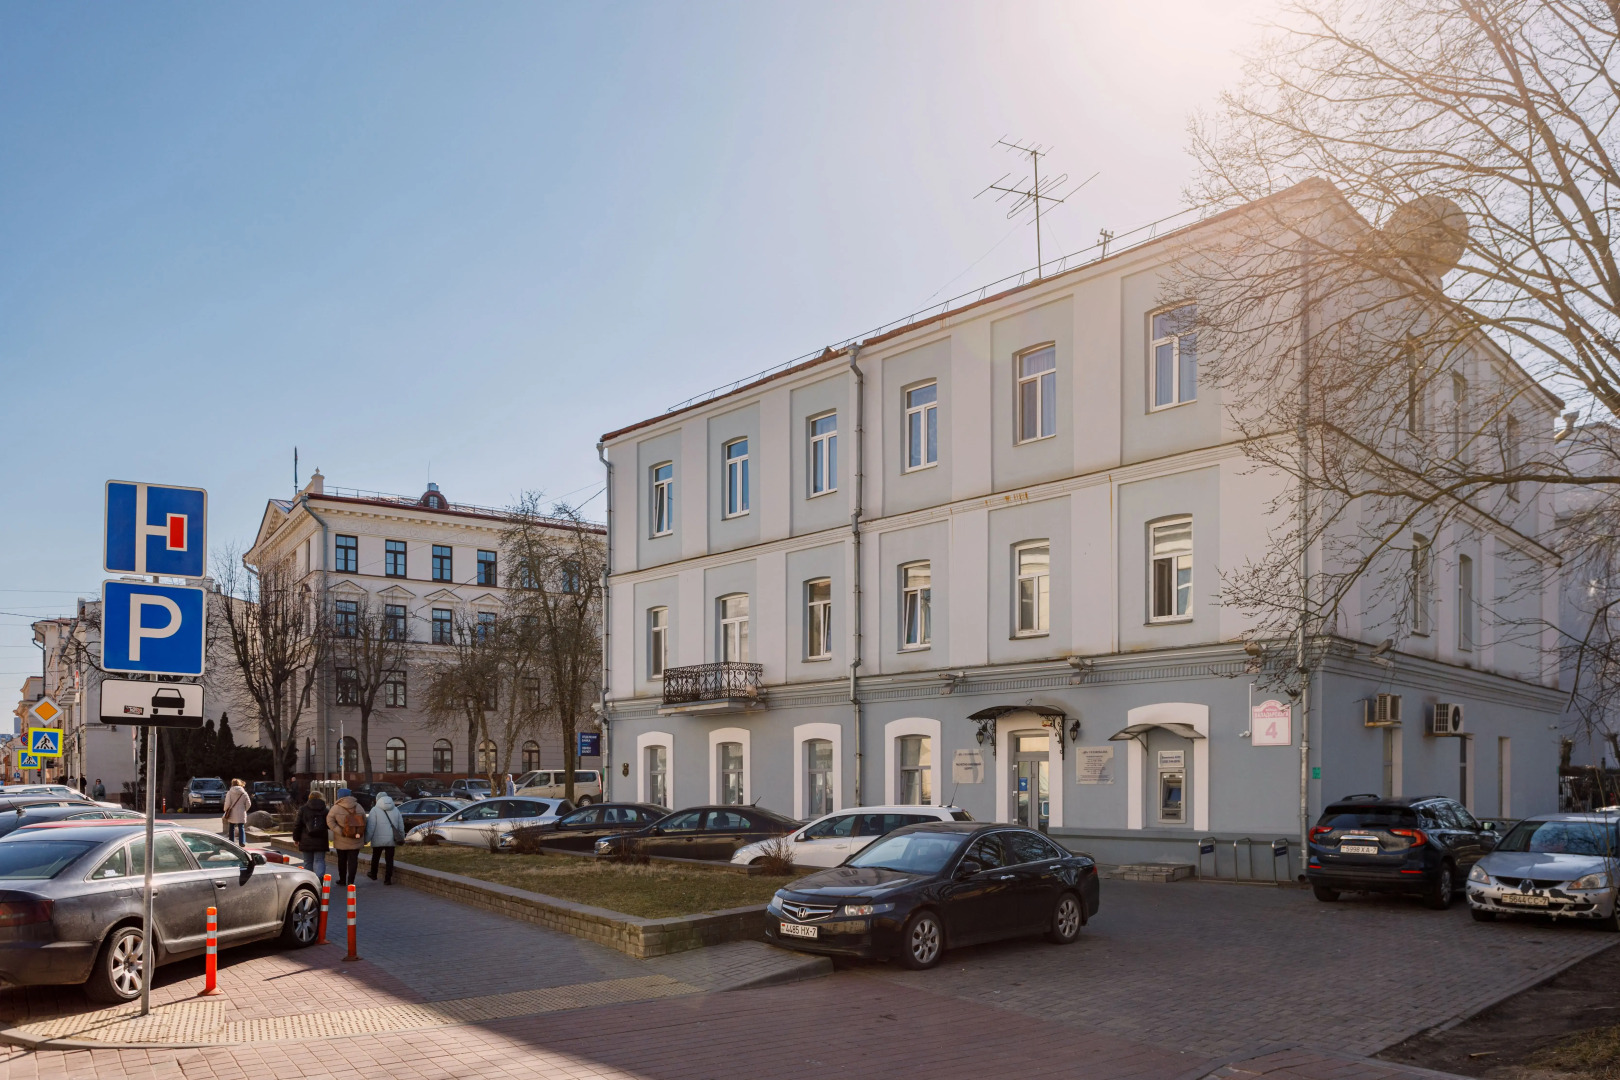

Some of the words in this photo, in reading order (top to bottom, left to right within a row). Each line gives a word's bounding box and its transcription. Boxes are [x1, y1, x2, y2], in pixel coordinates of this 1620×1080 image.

[129, 593, 183, 662] P
[1265, 721, 1278, 739] 4
[785, 924, 800, 935] 4485
[800, 926, 817, 937] HX-7
